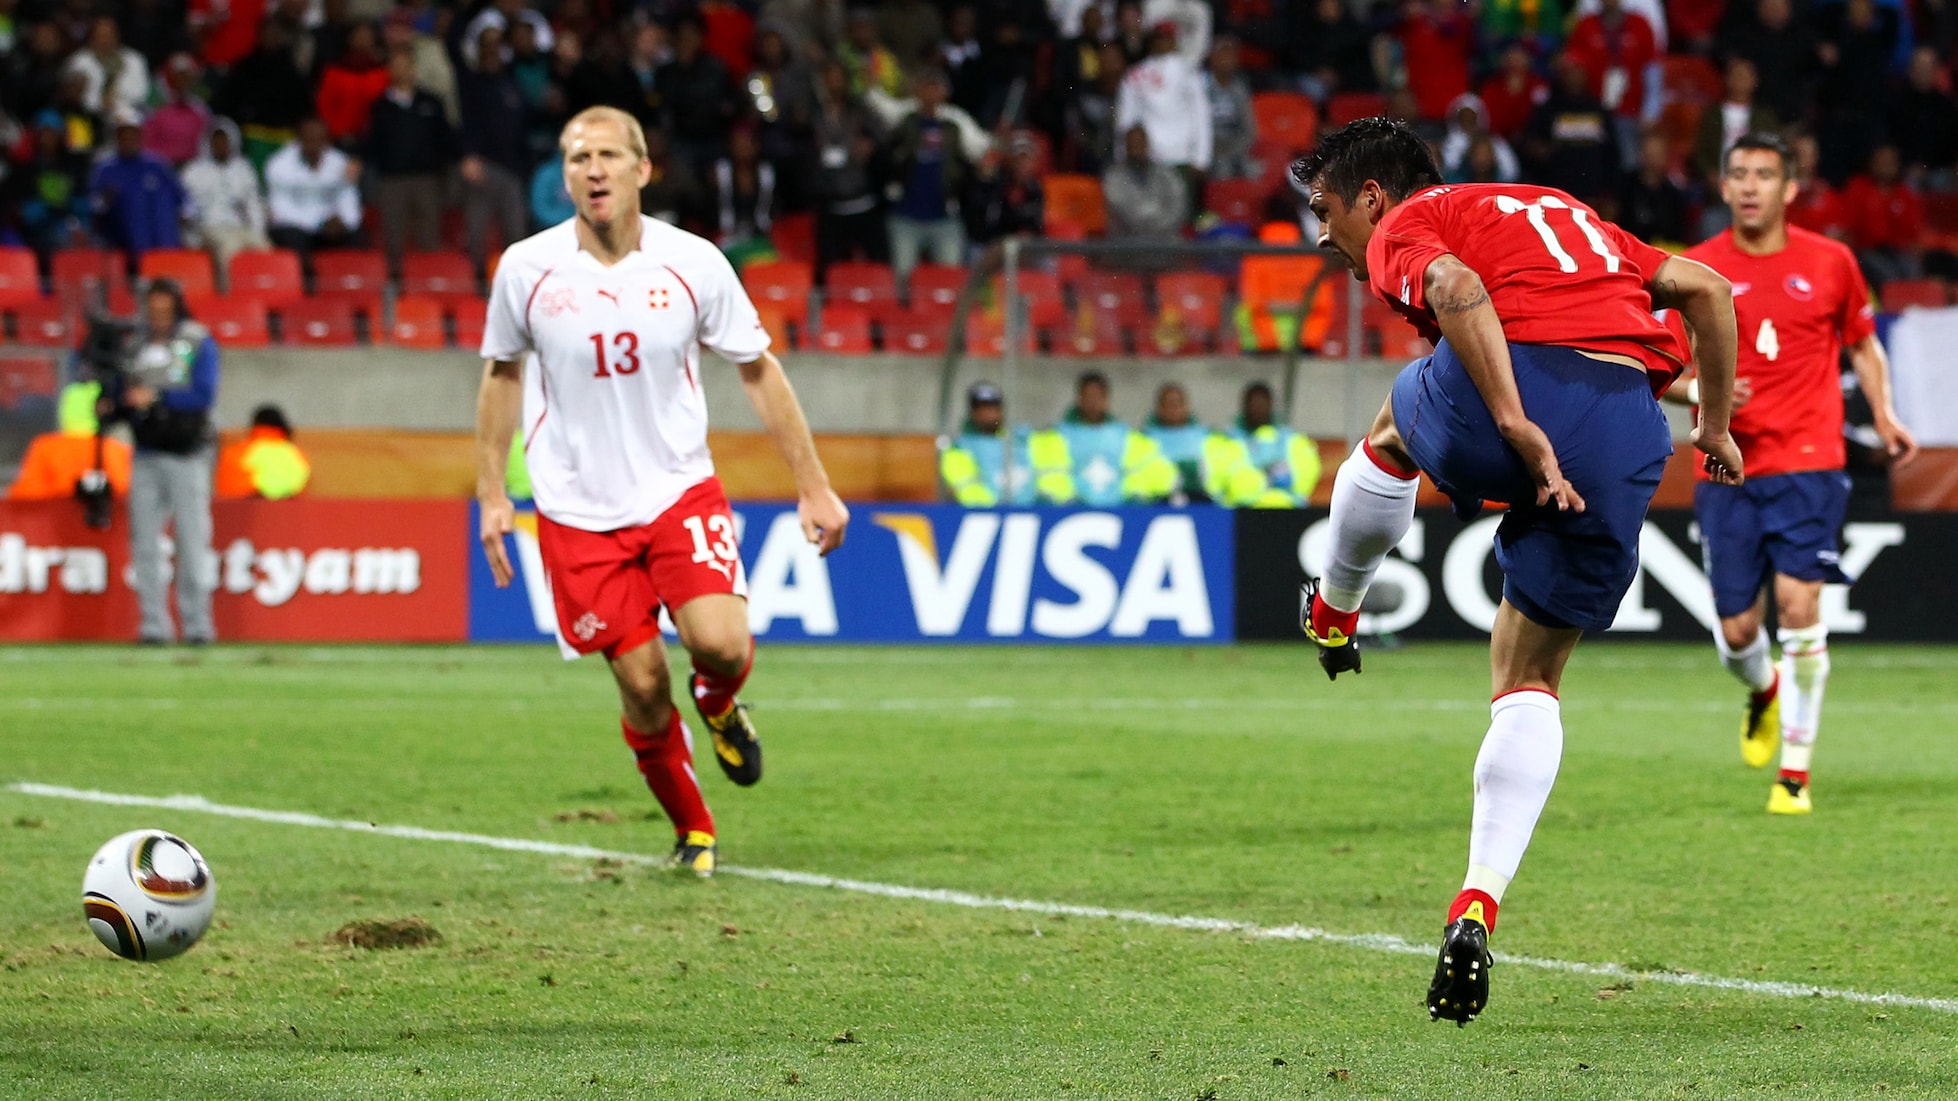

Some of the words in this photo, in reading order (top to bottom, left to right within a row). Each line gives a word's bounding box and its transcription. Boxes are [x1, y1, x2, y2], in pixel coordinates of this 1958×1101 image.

[1496, 194, 1620, 273] 11
[589, 331, 640, 377] 13
[1756, 318, 1780, 361] 4
[684, 514, 738, 563] 13
[871, 512, 1214, 637] VISA
